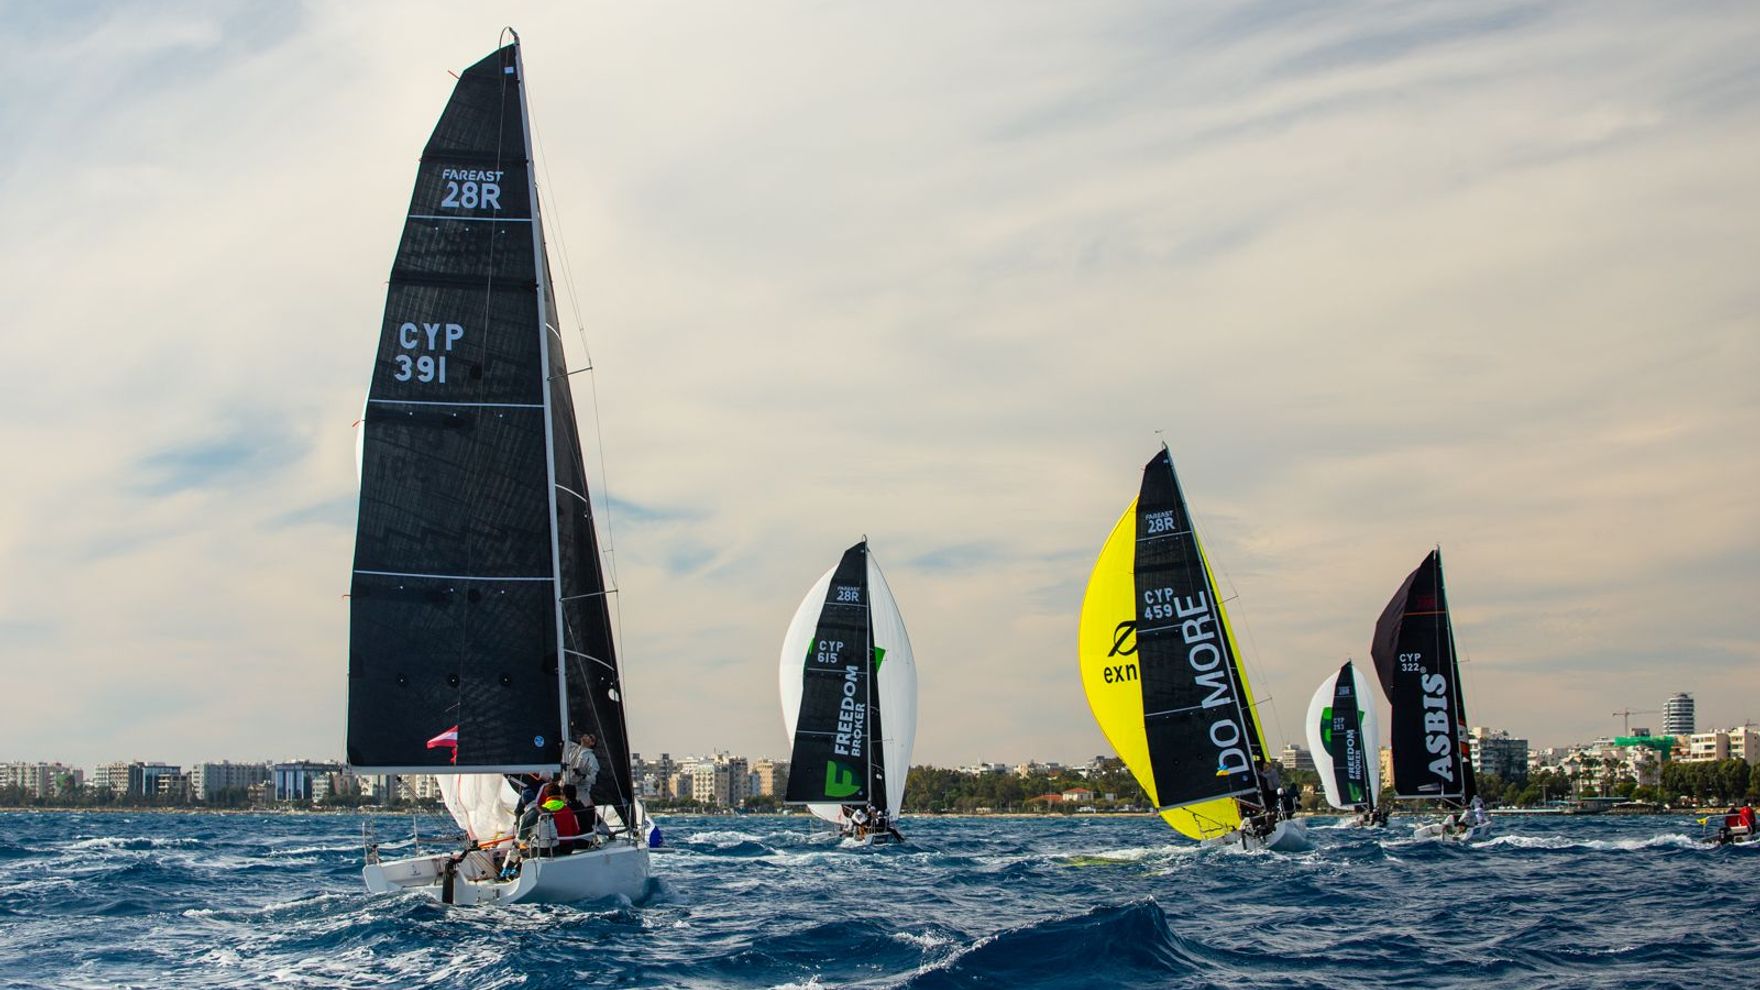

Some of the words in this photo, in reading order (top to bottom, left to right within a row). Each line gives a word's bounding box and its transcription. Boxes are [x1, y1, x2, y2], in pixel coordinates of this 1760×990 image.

[442, 168, 504, 182] FAREAST
[441, 182, 501, 209] 28R
[400, 322, 464, 350] CYP
[394, 354, 446, 384] 391
[1147, 517, 1176, 533] 28R
[836, 591, 860, 602] 28R
[1144, 587, 1174, 604] CYP
[1144, 603, 1173, 620] 459
[819, 640, 844, 652] CYP
[1174, 591, 1231, 709] MORE
[817, 652, 838, 664] 615
[1399, 653, 1421, 662] CYP
[1401, 663, 1419, 672] 322
[834, 665, 859, 756] FREEDOM
[851, 703, 866, 757] BROKER
[1421, 673, 1454, 783] ASBIS
[1209, 719, 1250, 775] DO
[1346, 729, 1356, 780] FREEDOM
